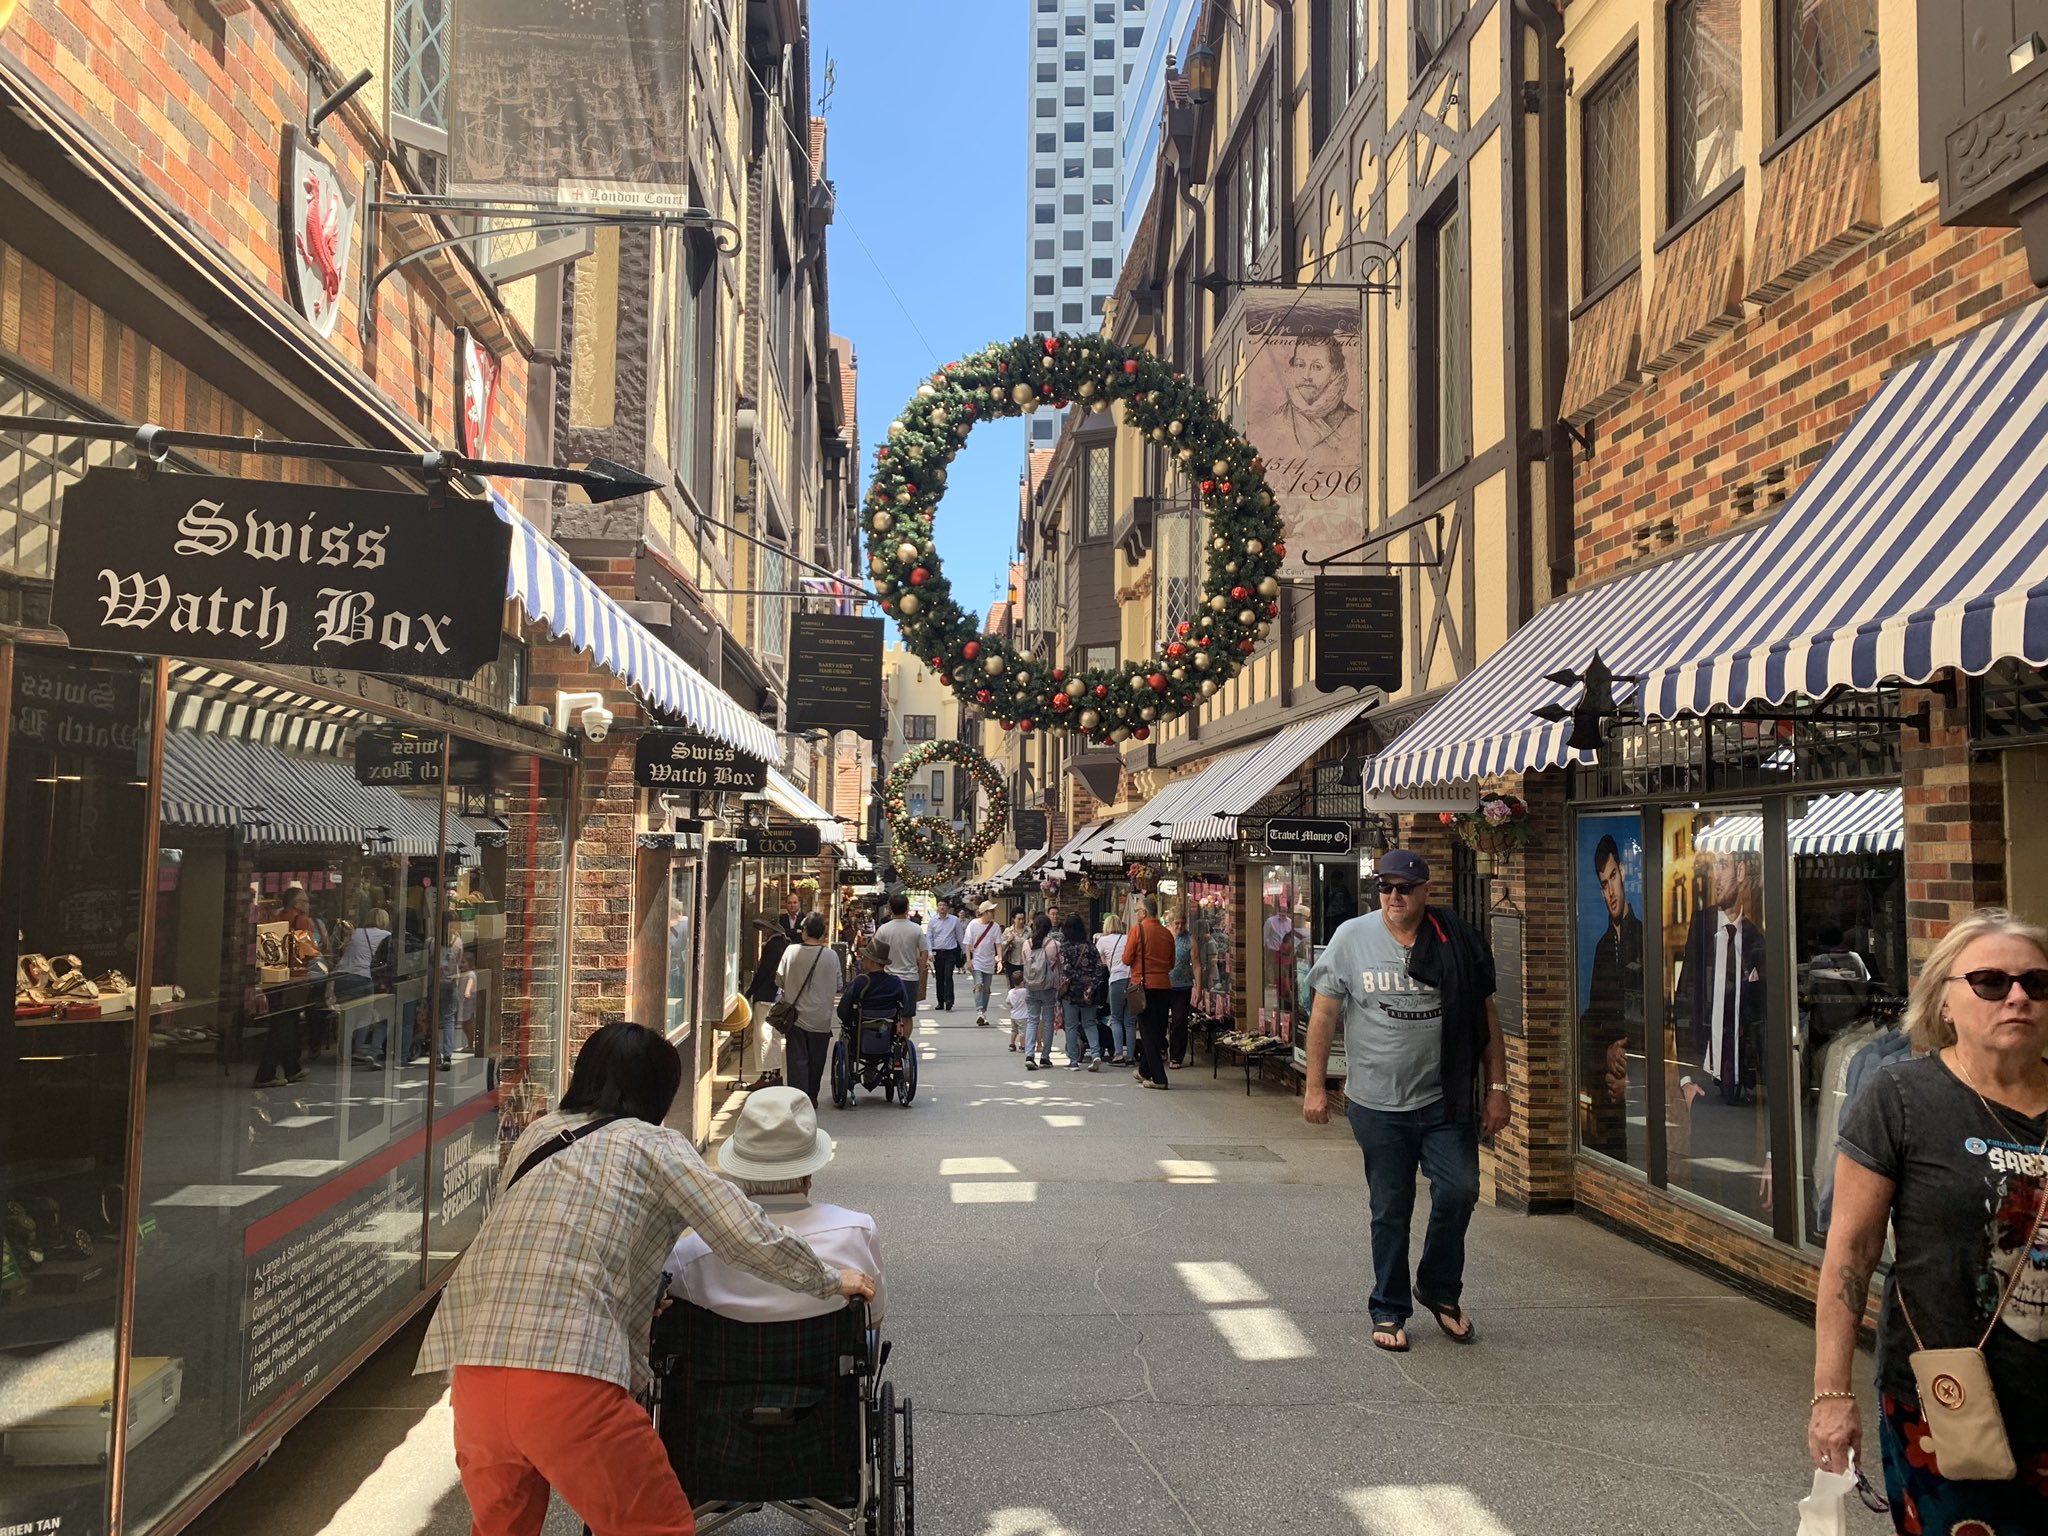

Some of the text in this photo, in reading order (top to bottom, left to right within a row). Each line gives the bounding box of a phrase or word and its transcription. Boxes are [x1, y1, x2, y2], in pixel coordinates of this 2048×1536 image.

[591, 188, 683, 205] London Court
[1264, 457, 1308, 475] 1544
[1289, 467, 1361, 501] 1596
[174, 498, 390, 570] Swiss
[97, 568, 452, 655] Watch Box
[671, 741, 735, 761] Swiss
[649, 763, 755, 786] Watch Box
[1269, 828, 1348, 844] Travel Money Oz
[1362, 971, 1434, 993] BULL
[444, 1131, 472, 1171] LUXURY
[442, 1161, 467, 1198] SWISS
[441, 1175, 481, 1226] SPECIALIST
[262, 1255, 281, 1279] Lange
[252, 1296, 273, 1320] Corum
[277, 1281, 295, 1302] Devon
[299, 1271, 311, 1287] Dior
[315, 1256, 331, 1276] Franck
[253, 1283, 265, 1300] Bell
[271, 1270, 286, 1288] Ross
[280, 1295, 302, 1321] Original
[305, 1280, 323, 1300] Hublot
[326, 1271, 337, 1286] IWC
[252, 1368, 274, 1396] U-Boat
[278, 1350, 297, 1377] Ulysse
[297, 1335, 315, 1358] Nardin
[318, 1319, 336, 1341] Urwerk
[339, 1299, 360, 1323] Vacheron
[361, 1281, 383, 1306] Constantin
[253, 1354, 270, 1376] Patek
[271, 1336, 294, 1364] Philippe
[328, 1296, 346, 1317] Richard
[347, 1287, 357, 1302] Mille
[361, 1275, 373, 1291] Rolex
[254, 1335, 271, 1357] Louis
[272, 1320, 291, 1343] Moinet
[295, 1302, 316, 1325] Maurice
[316, 1288, 334, 1310] Lacroix
[36, 1516, 61, 1531] TAN
